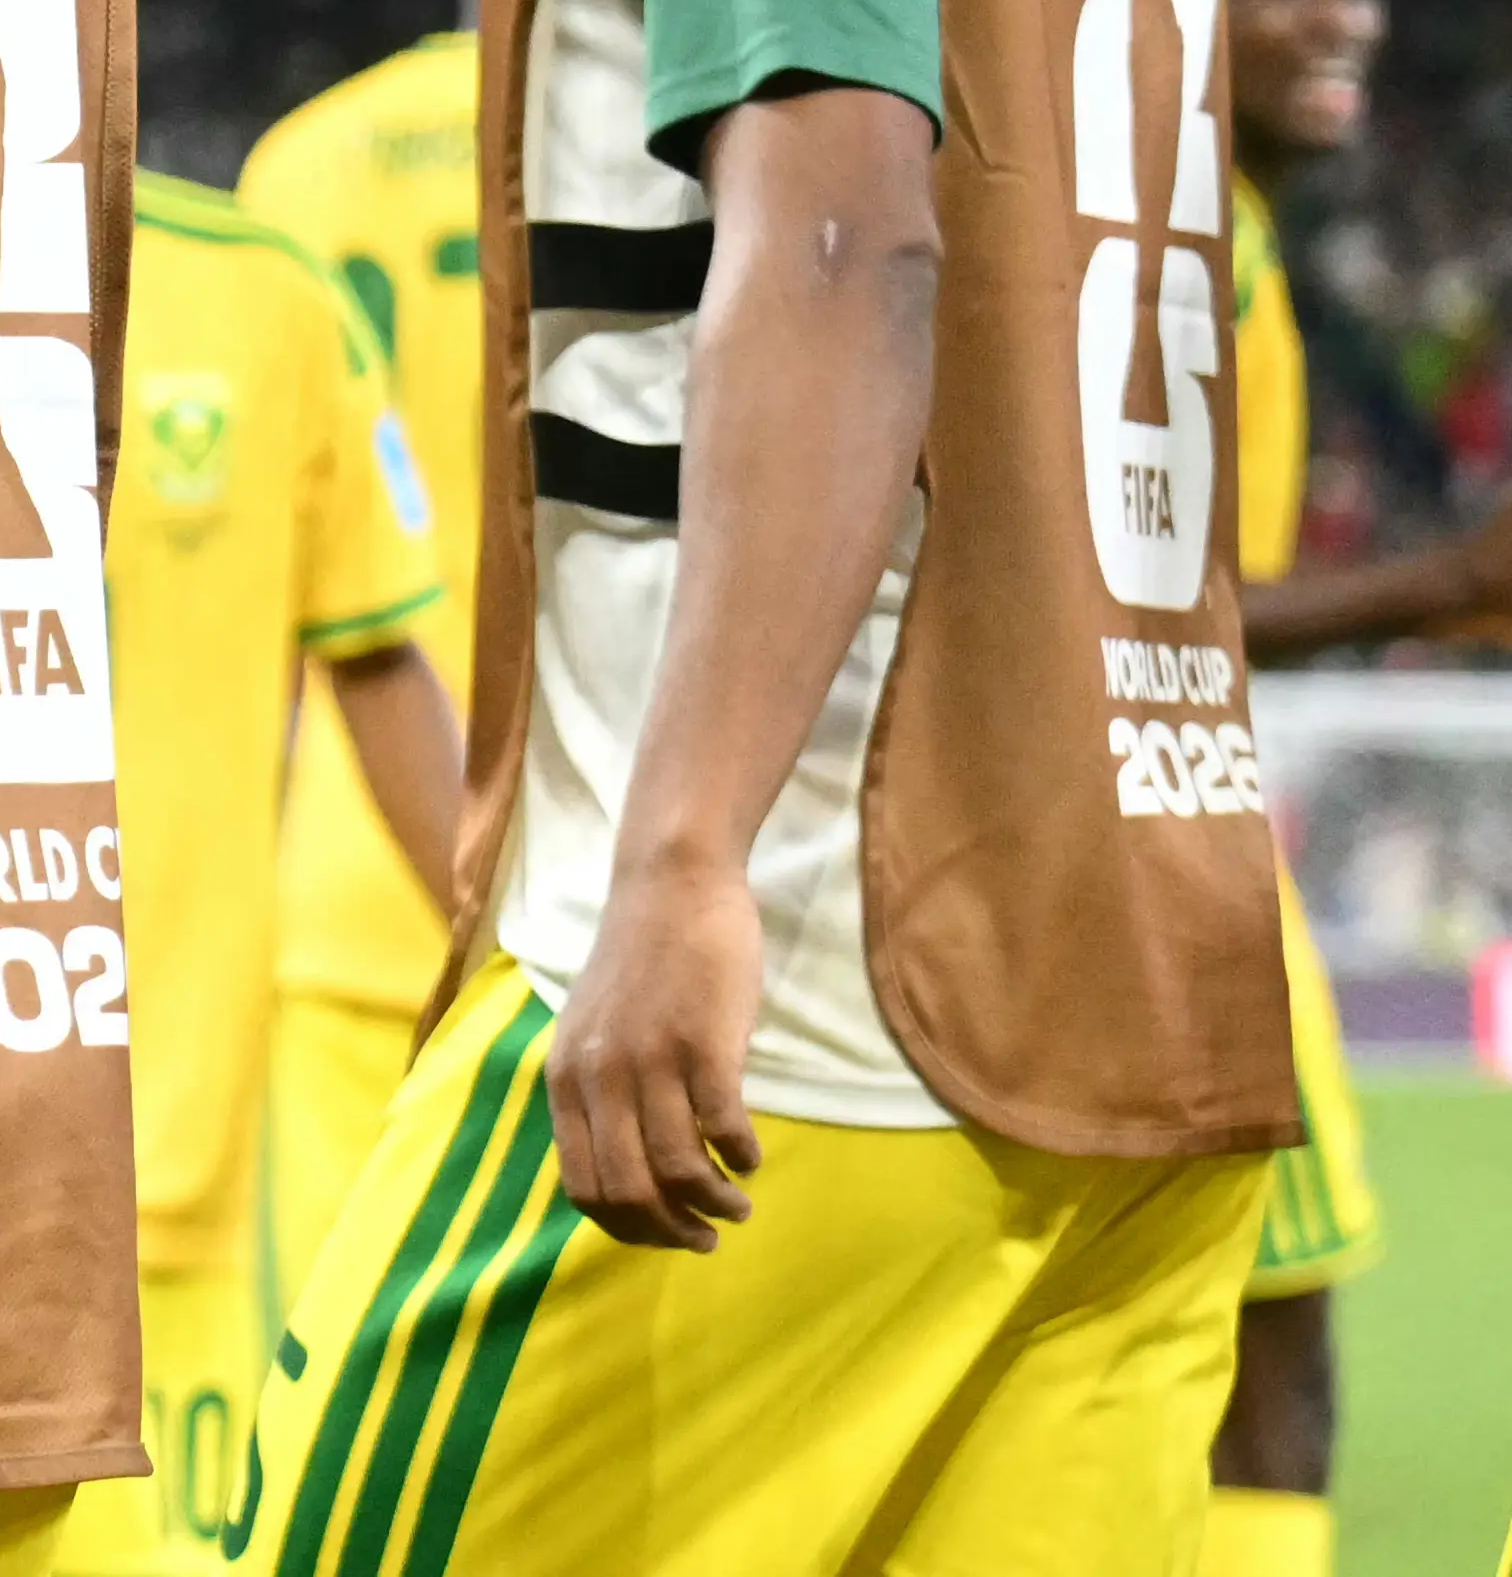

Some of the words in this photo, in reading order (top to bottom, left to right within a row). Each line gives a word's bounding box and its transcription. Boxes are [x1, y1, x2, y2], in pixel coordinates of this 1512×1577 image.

[1121, 462, 1176, 540] FIFA
[1179, 643, 1235, 708] CUP
[1108, 717, 1265, 819] 2026
